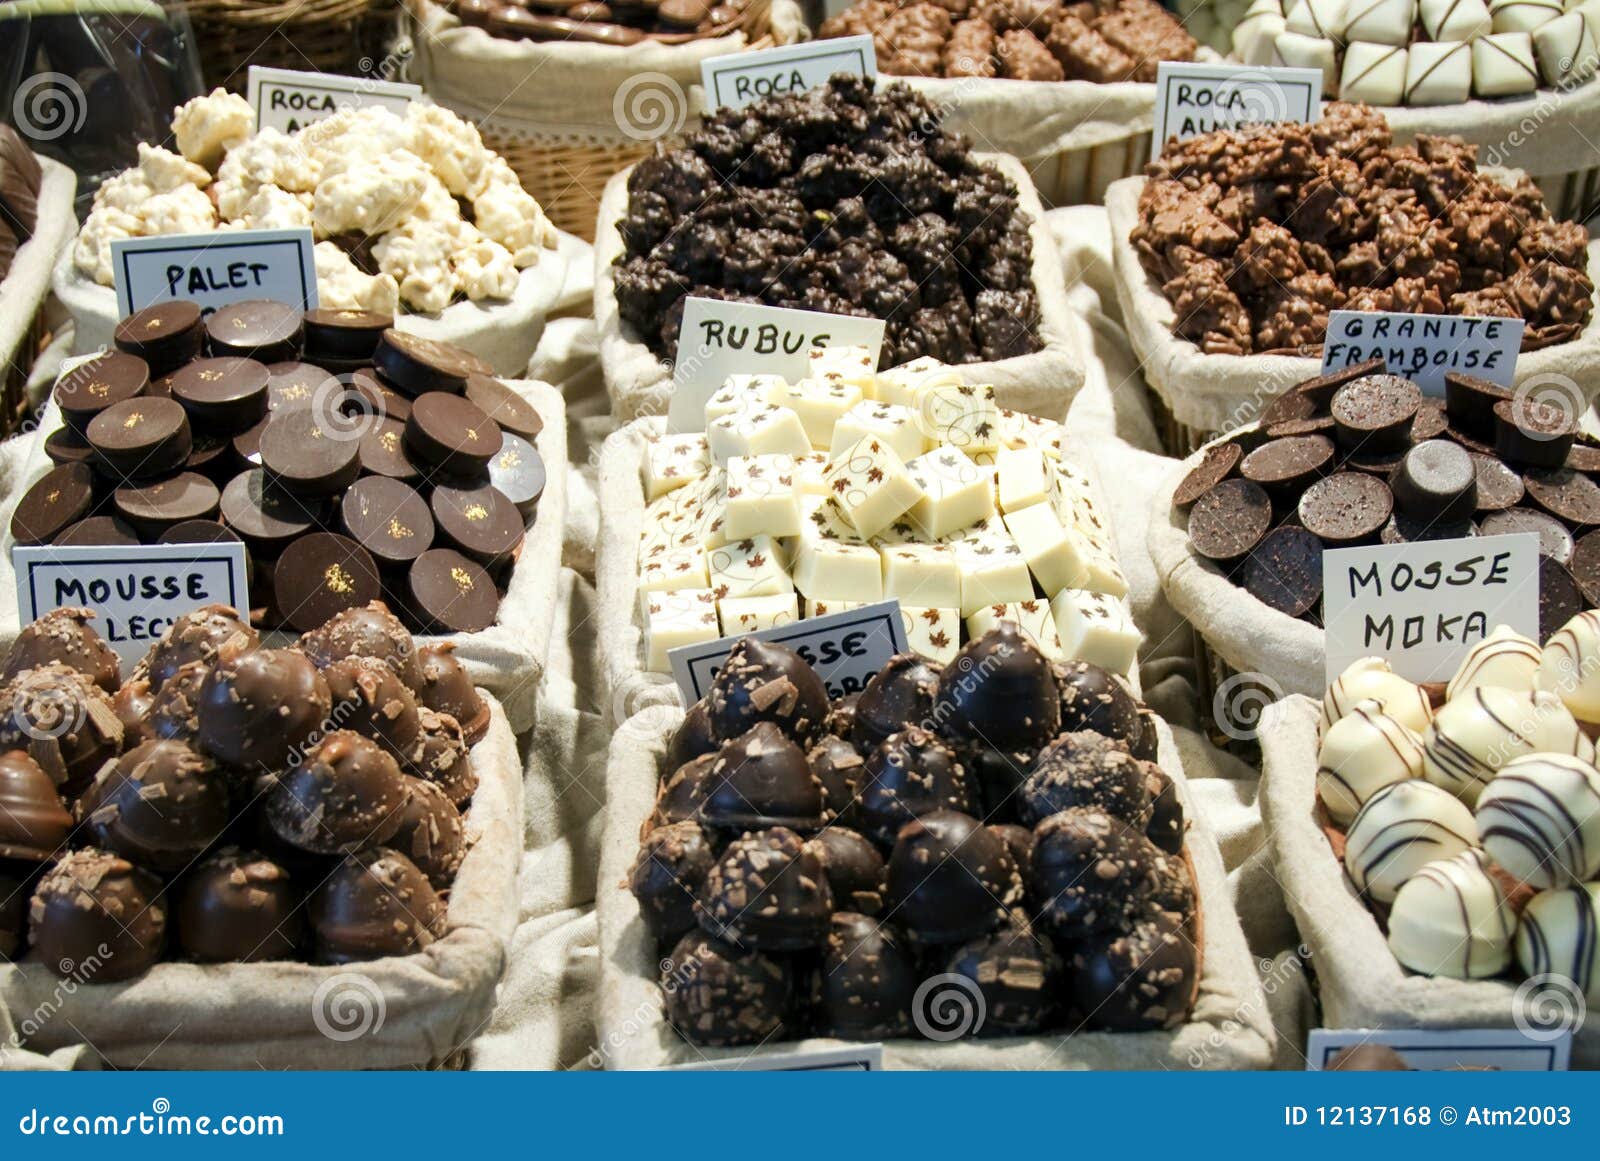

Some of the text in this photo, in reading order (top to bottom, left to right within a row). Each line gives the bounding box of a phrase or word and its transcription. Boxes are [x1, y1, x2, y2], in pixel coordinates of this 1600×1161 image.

[735, 69, 807, 100] ROCA
[1177, 84, 1246, 110] ROCA
[271, 89, 336, 112] ROCA
[166, 262, 268, 297] PALET
[1344, 317, 1503, 340] GRANITE
[1325, 343, 1503, 369] FRAMBOISE
[1348, 552, 1511, 598] MOSSE
[55, 573, 209, 606] MOUSSE
[106, 616, 179, 641] LEC
[1364, 611, 1487, 650] MOKA
